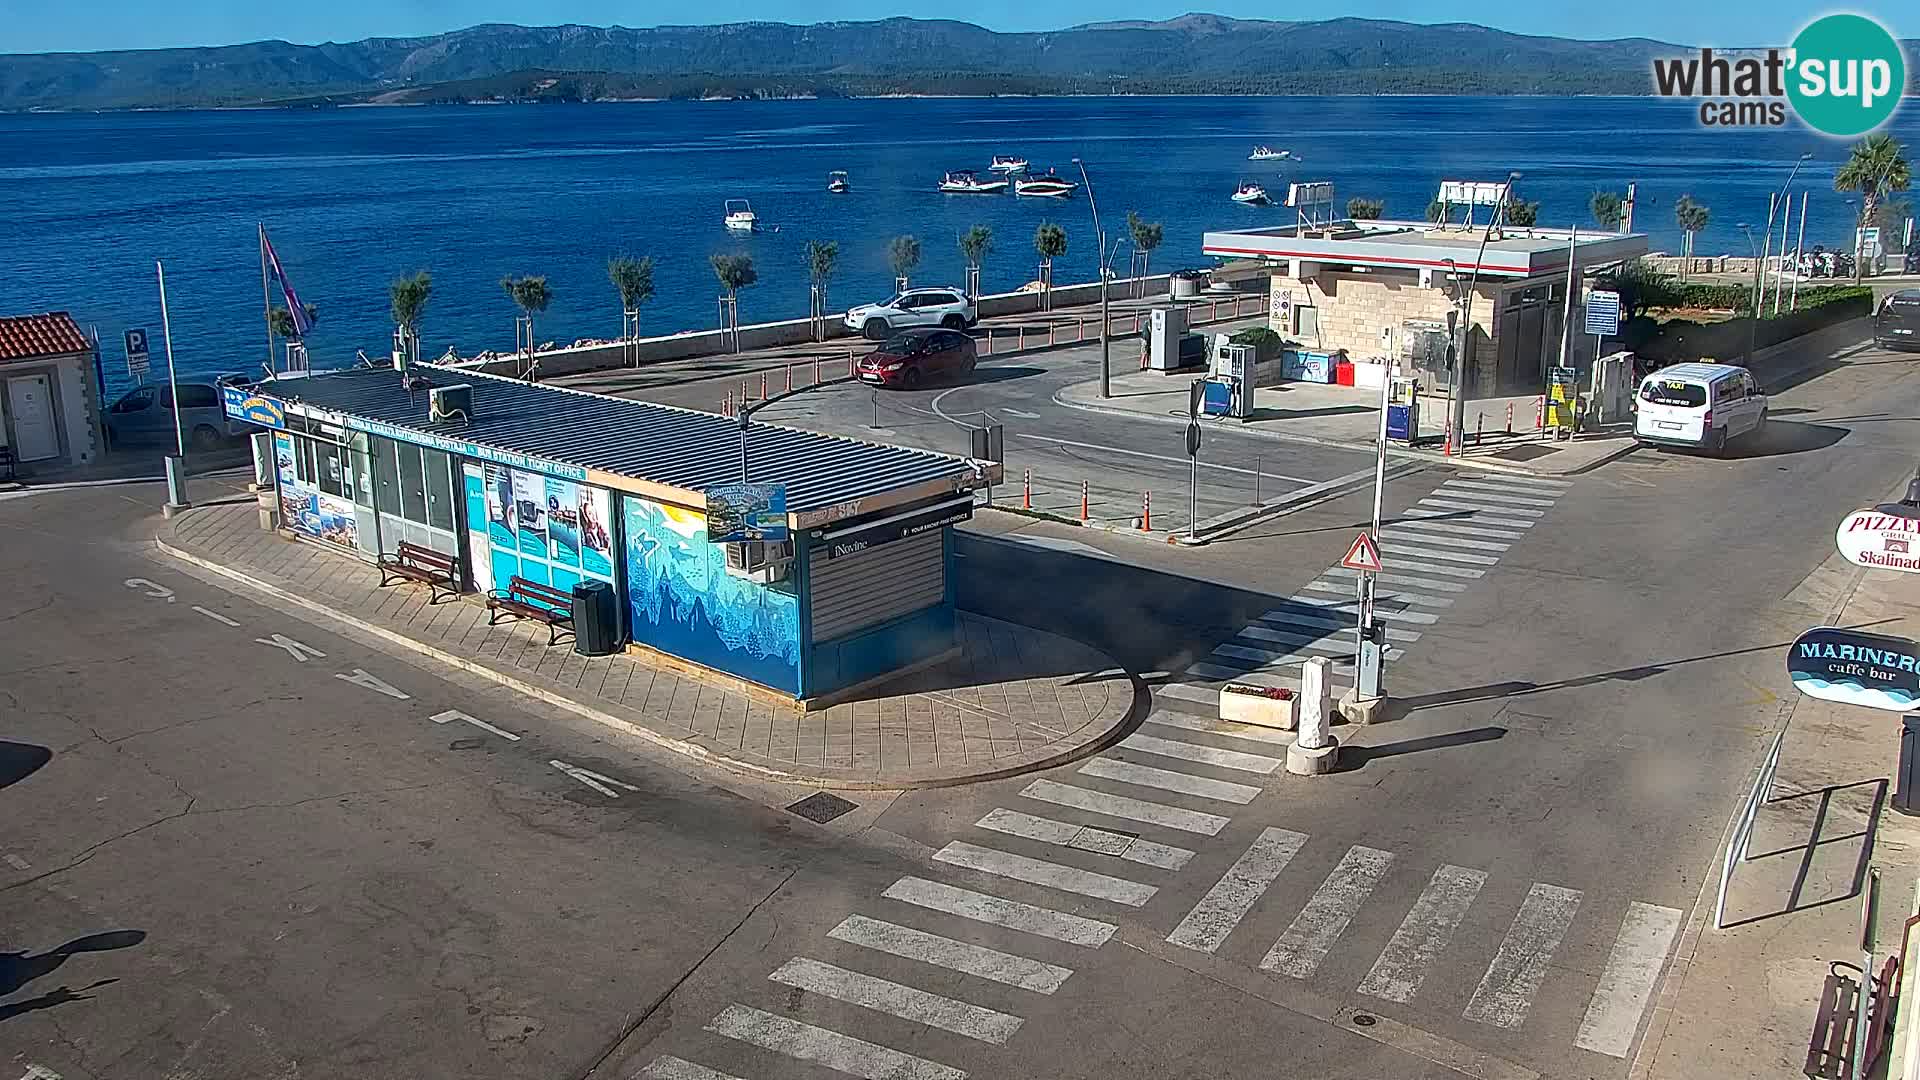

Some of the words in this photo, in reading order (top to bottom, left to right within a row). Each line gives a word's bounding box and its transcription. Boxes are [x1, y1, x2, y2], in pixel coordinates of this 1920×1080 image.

[129, 333, 142, 351] P
[1666, 381, 1684, 390] TAXI
[476, 448, 489, 458] BUS
[490, 451, 523, 466] STATION
[525, 457, 551, 473] TICKET
[553, 464, 582, 479] OFFICE
[1848, 516, 1920, 534] PIZZE
[1881, 531, 1916, 541] GRILL
[1829, 663, 1865, 676] caffe
[1869, 666, 1896, 682] bar
